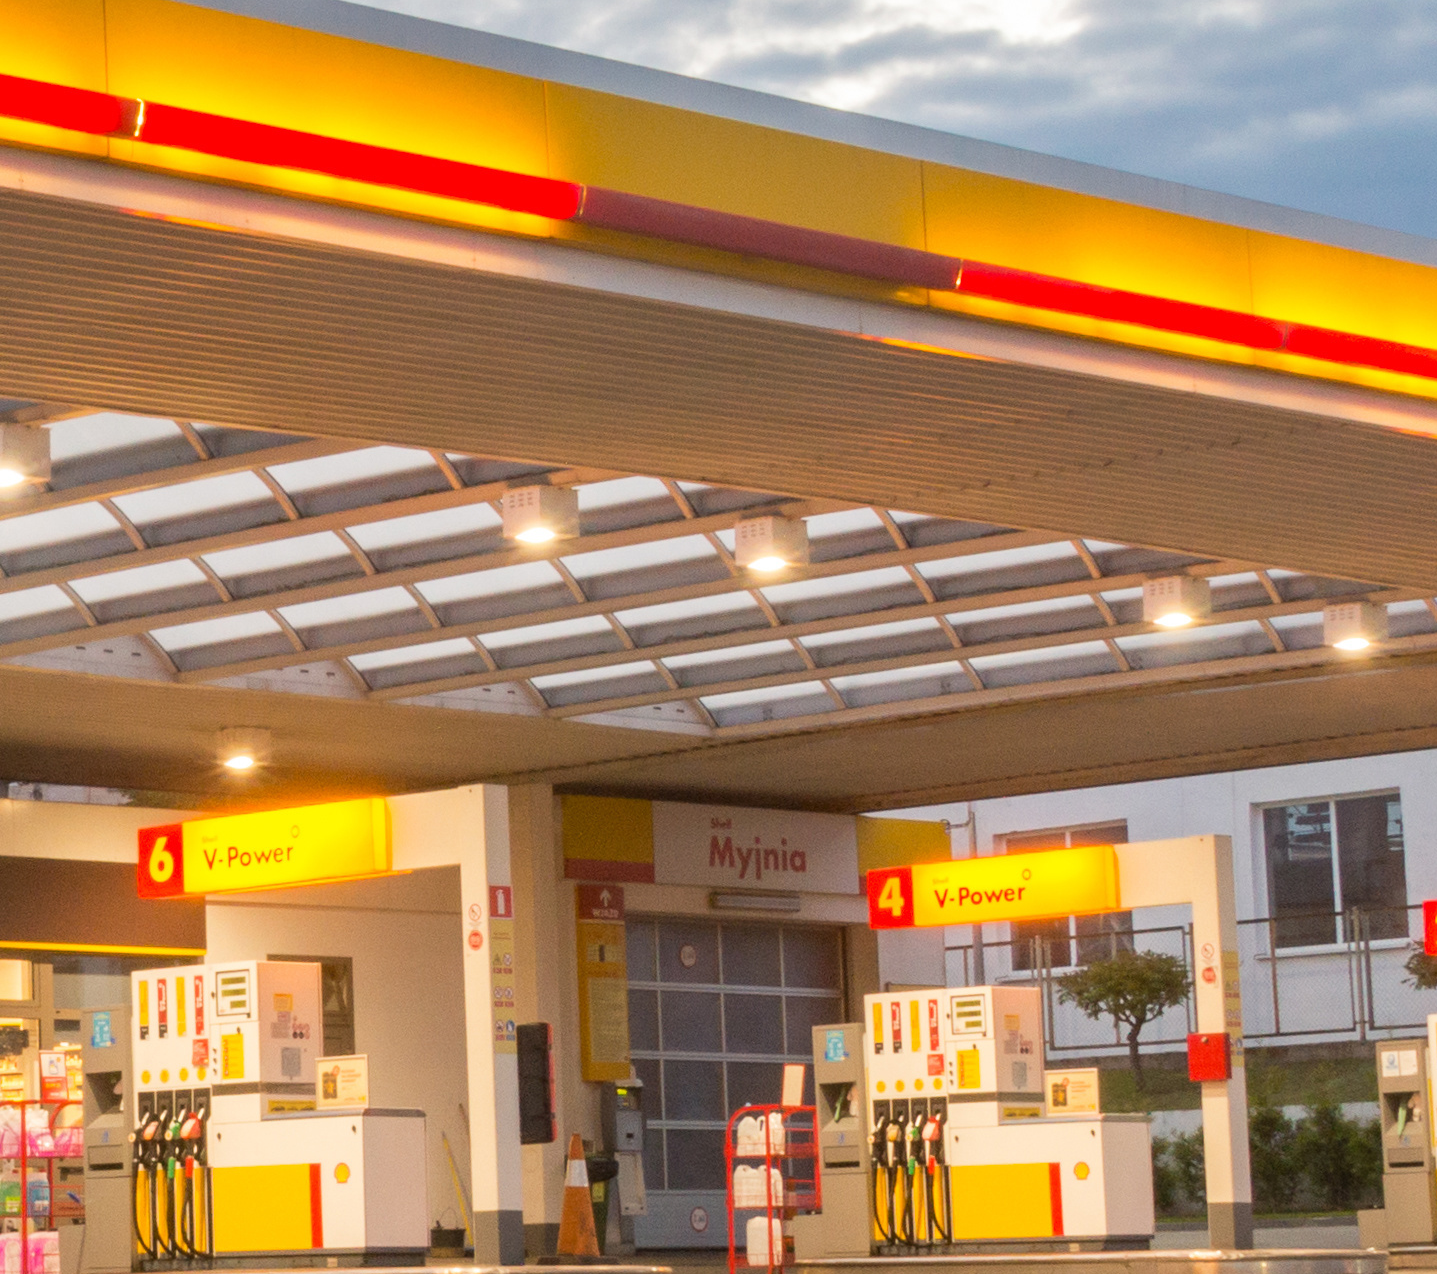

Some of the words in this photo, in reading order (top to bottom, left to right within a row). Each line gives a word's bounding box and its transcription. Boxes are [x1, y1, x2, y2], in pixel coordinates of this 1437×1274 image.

[711, 817, 732, 829] Shell
[149, 836, 174, 883] 6
[203, 846, 294, 870] V-Power
[709, 835, 807, 880] Myjnia
[878, 877, 905, 917] 4
[934, 886, 1025, 909] V-Power
